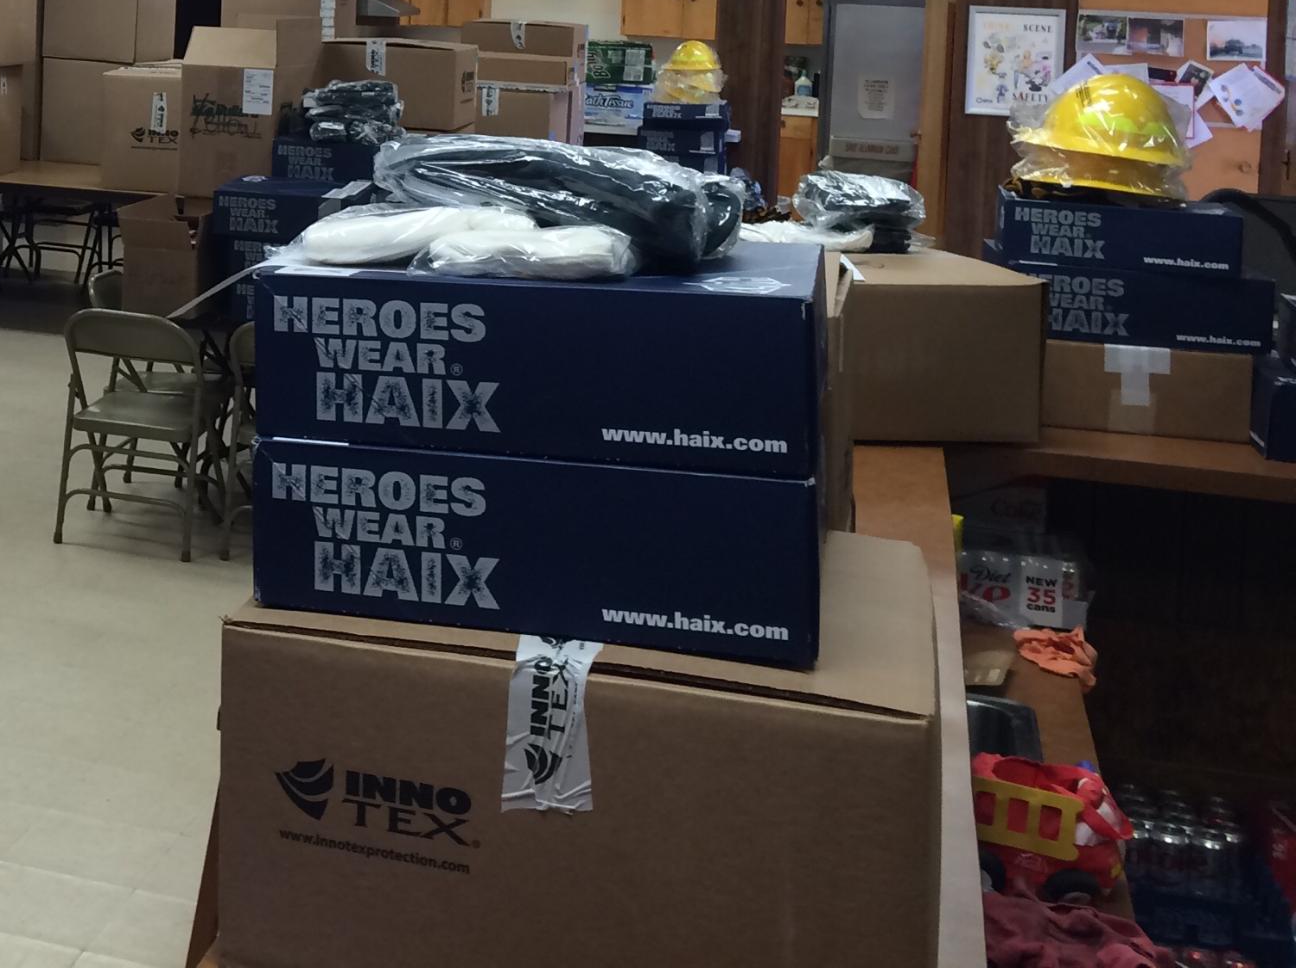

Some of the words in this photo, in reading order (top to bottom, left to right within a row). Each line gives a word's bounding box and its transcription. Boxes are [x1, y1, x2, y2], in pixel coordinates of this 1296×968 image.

[1023, 23, 1052, 33] SCENE
[277, 144, 333, 159] HEROES
[288, 156, 322, 167] WEAR
[287, 167, 335, 182] HAIX
[218, 195, 277, 211] HEROES
[230, 206, 267, 219] WEAR
[229, 216, 279, 235] HAIX
[1014, 206, 1103, 228] HEROES
[1031, 222, 1086, 239] WEAR
[1029, 235, 1106, 261] HAIX
[1142, 255, 1230, 271] www.haix.com
[273, 294, 488, 343] HEROES
[1175, 332, 1262, 350] www.haix.com
[315, 371, 502, 433] HAIX
[601, 427, 788, 454] www.haix.com
[271, 461, 488, 517] HEROES
[313, 539, 501, 611] HAIX
[969, 564, 1012, 584] Diet
[1025, 575, 1058, 588] NEW
[1027, 586, 1056, 606] 35
[1026, 602, 1056, 614] cans
[600, 607, 790, 642] www.haix.com
[530, 656, 554, 737] INNO
[548, 656, 570, 740] TEX
[344, 769, 472, 816] INNO
[341, 797, 474, 847] TEX
[278, 828, 472, 875] www.innotexprotection.com
